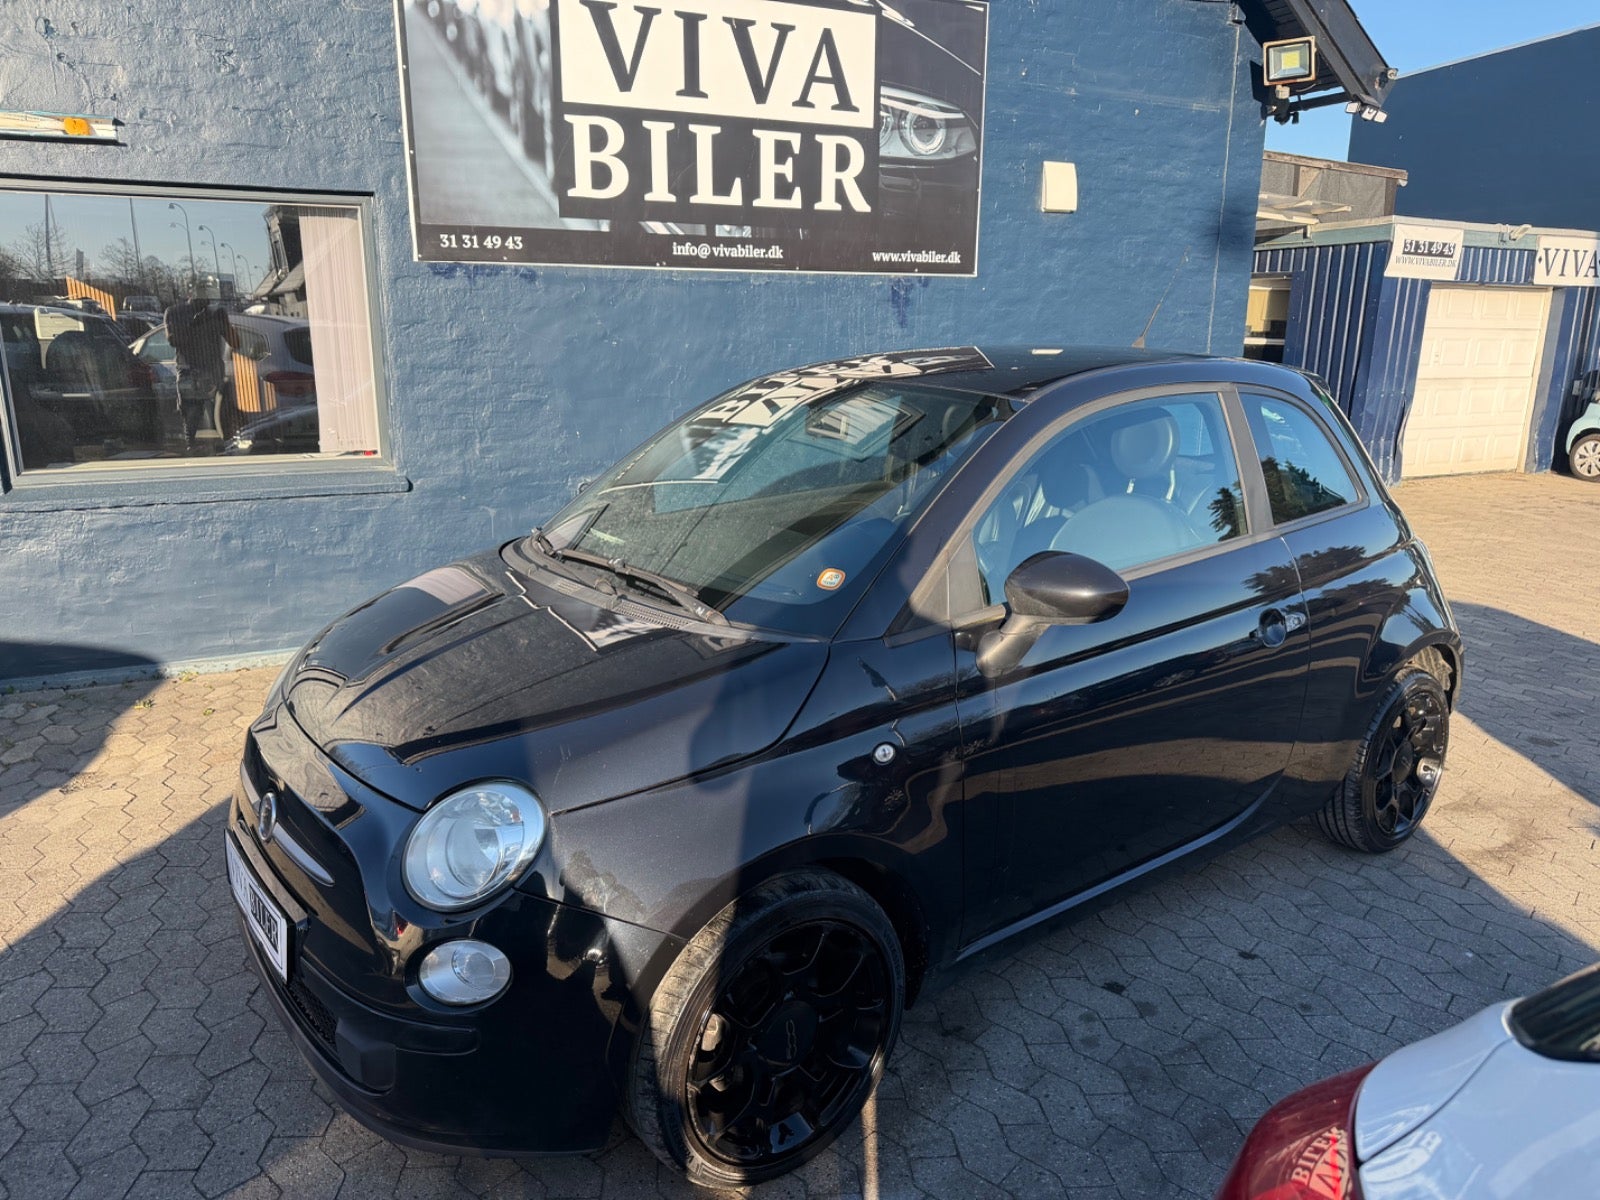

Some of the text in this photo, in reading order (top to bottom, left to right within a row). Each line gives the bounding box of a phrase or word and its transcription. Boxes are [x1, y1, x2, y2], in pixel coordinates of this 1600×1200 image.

[579, 0, 860, 112] VIVA
[563, 114, 872, 212] BILER
[440, 234, 523, 250] 31 31 49 43
[1404, 240, 1455, 255] 31 31 49 43
[872, 249, 961, 264] www.vivabiler.dk
[1543, 248, 1599, 278] VIVA
